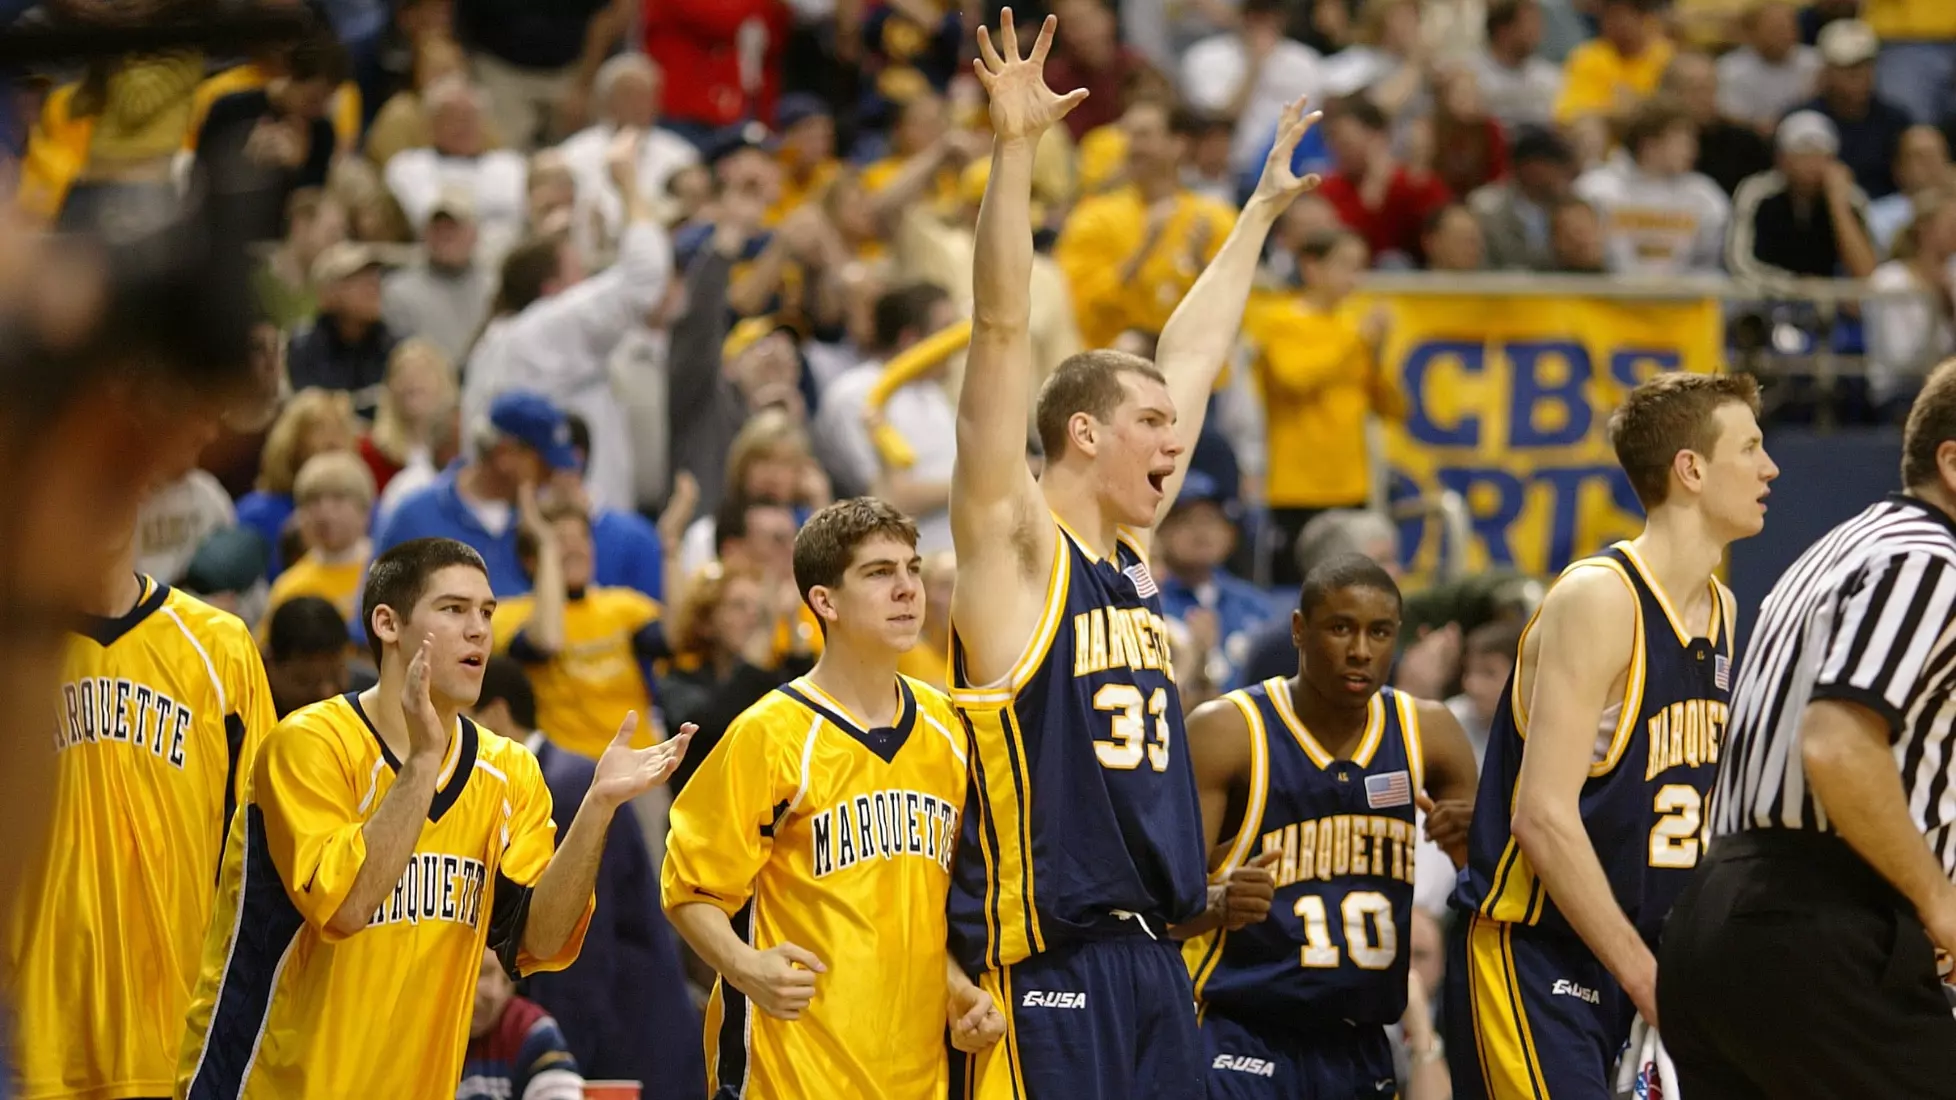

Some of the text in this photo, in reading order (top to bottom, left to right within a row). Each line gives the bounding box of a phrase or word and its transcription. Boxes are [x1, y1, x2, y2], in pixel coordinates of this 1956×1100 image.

[53, 677, 193, 770] RQUETTE
[1092, 683, 1170, 773] 33
[1293, 891, 1398, 971] 10
